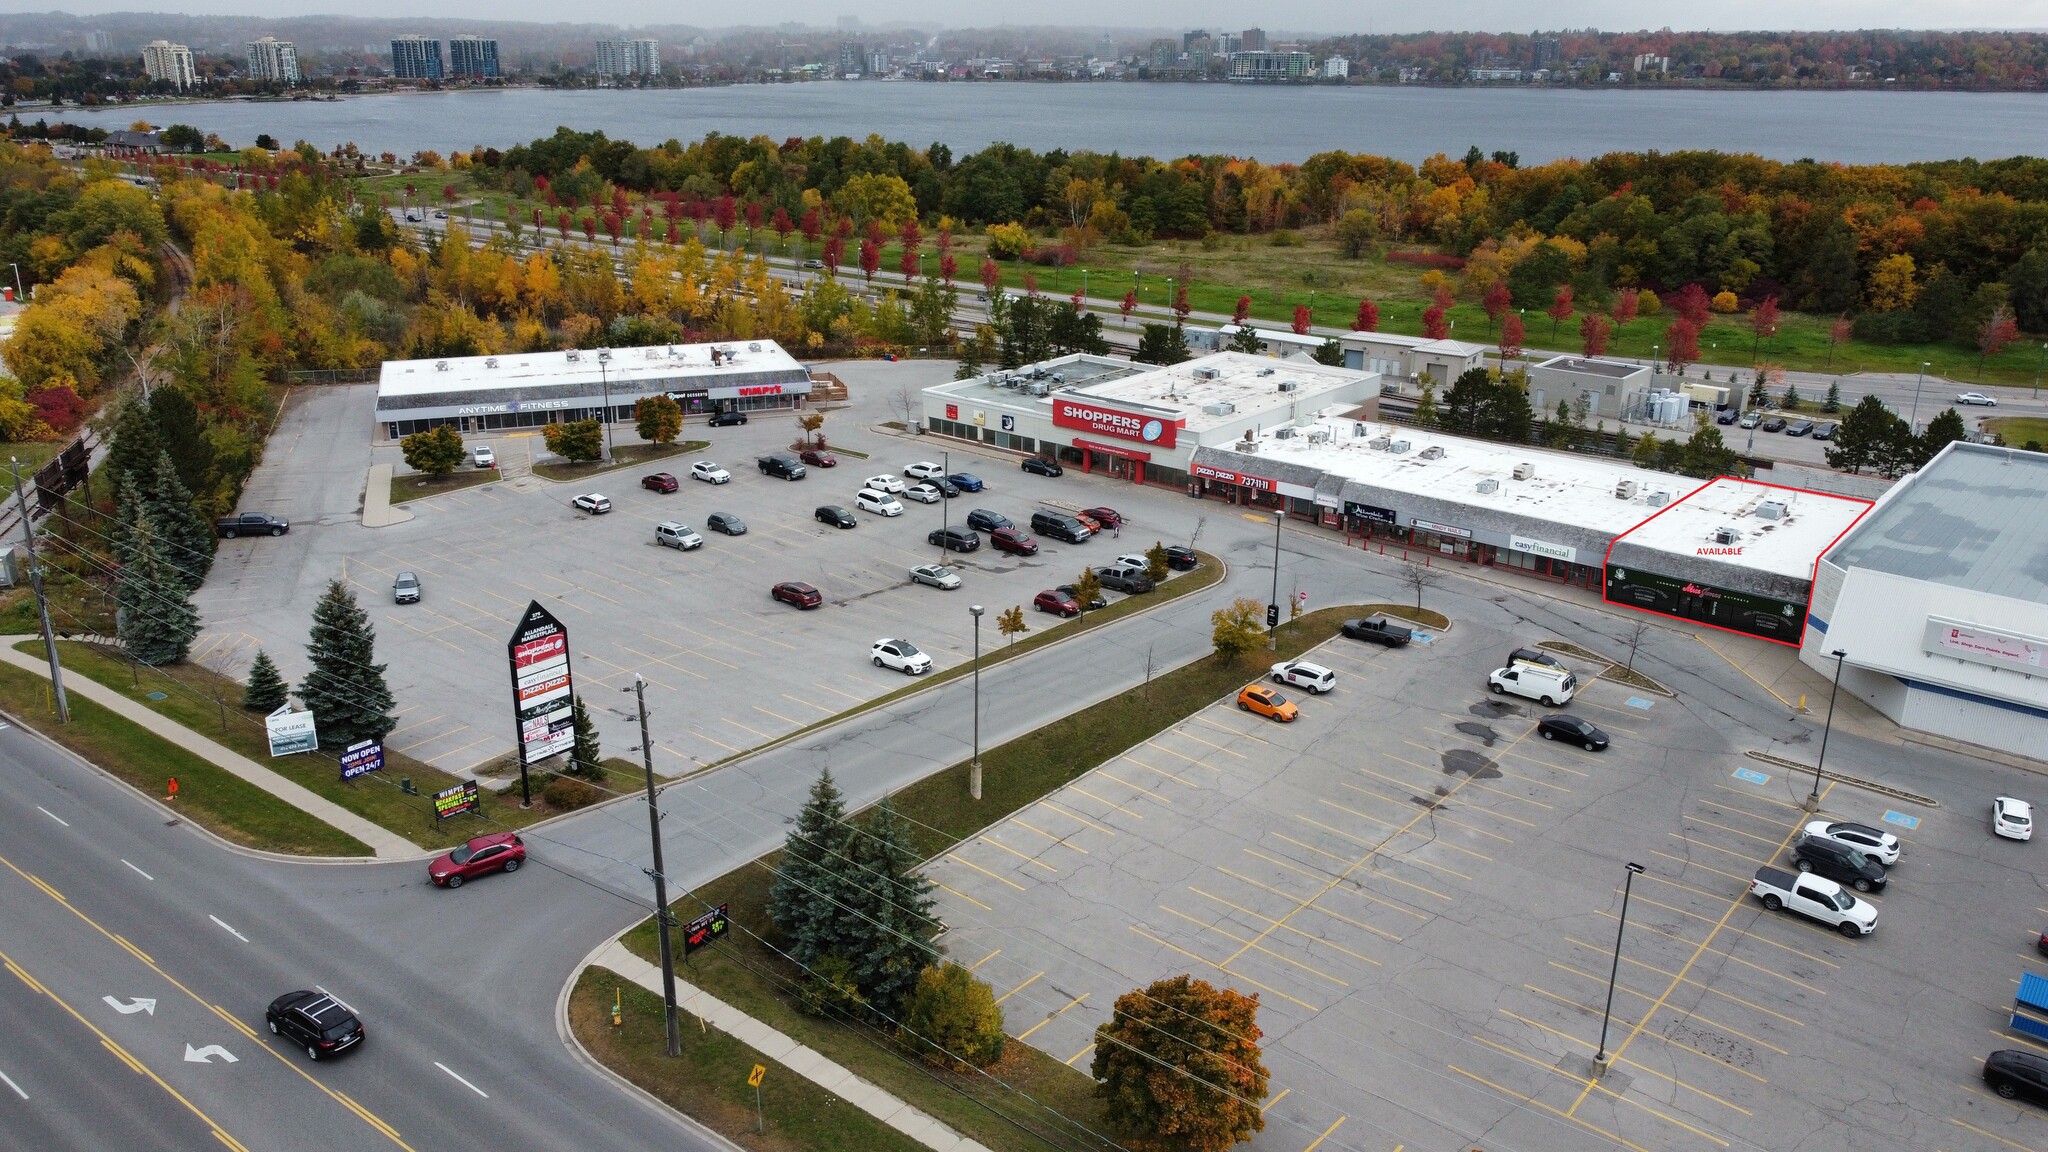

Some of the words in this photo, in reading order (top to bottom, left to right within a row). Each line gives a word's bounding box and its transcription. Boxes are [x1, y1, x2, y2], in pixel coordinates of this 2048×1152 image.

[458, 405, 507, 414] ANYTIME
[520, 400, 569, 410] FITNESS
[1063, 406, 1141, 430] SHOPPERS
[1092, 422, 1115, 433] DRUG
[1116, 428, 1140, 437] MART
[1196, 467, 1215, 476] pizza
[1215, 471, 1235, 481] pizza
[1447, 527, 1462, 535] NAILS
[1514, 540, 1570, 558] easyfinancial
[521, 627, 557, 643] MARKETPLACE
[524, 623, 554, 637] ALLANDALE
[517, 642, 554, 657] SHOPPERS
[524, 667, 563, 685] easyfinancial
[522, 684, 544, 698] pizza
[545, 676, 567, 690] pizza
[532, 715, 548, 728] NAILS
[341, 751, 360, 764] NOW
[360, 745, 381, 758] OPEN
[345, 764, 365, 777] OPEN
[365, 759, 381, 771] 24/7
[438, 798, 463, 812] SPECIALS
